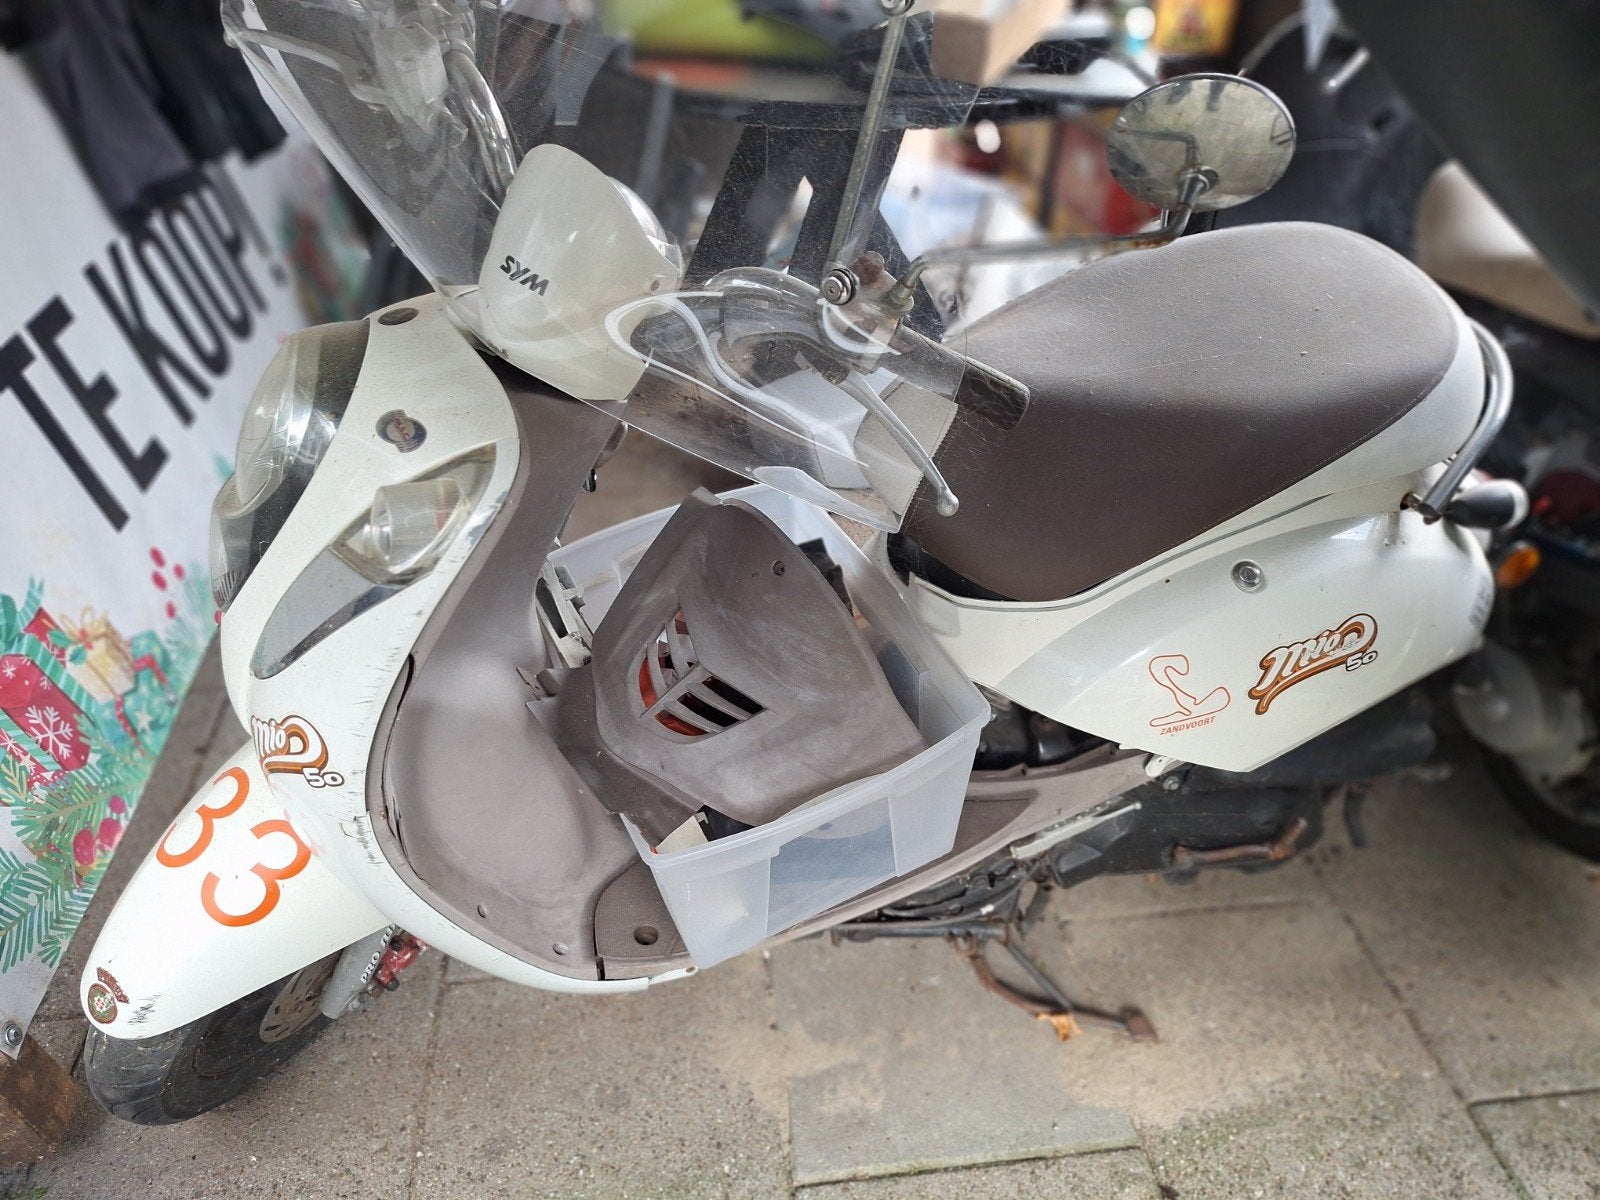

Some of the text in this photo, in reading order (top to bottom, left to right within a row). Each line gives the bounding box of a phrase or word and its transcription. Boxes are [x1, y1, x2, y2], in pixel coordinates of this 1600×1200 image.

[499, 254, 550, 297] SYM
[0, 166, 289, 532] TE KOOP!
[1247, 612, 1379, 716] Mio
[1345, 650, 1379, 672] 50
[1159, 715, 1217, 736] ZANDVOORT
[302, 767, 345, 788] 50
[155, 766, 312, 928] 33
[360, 950, 381, 984] PRO
